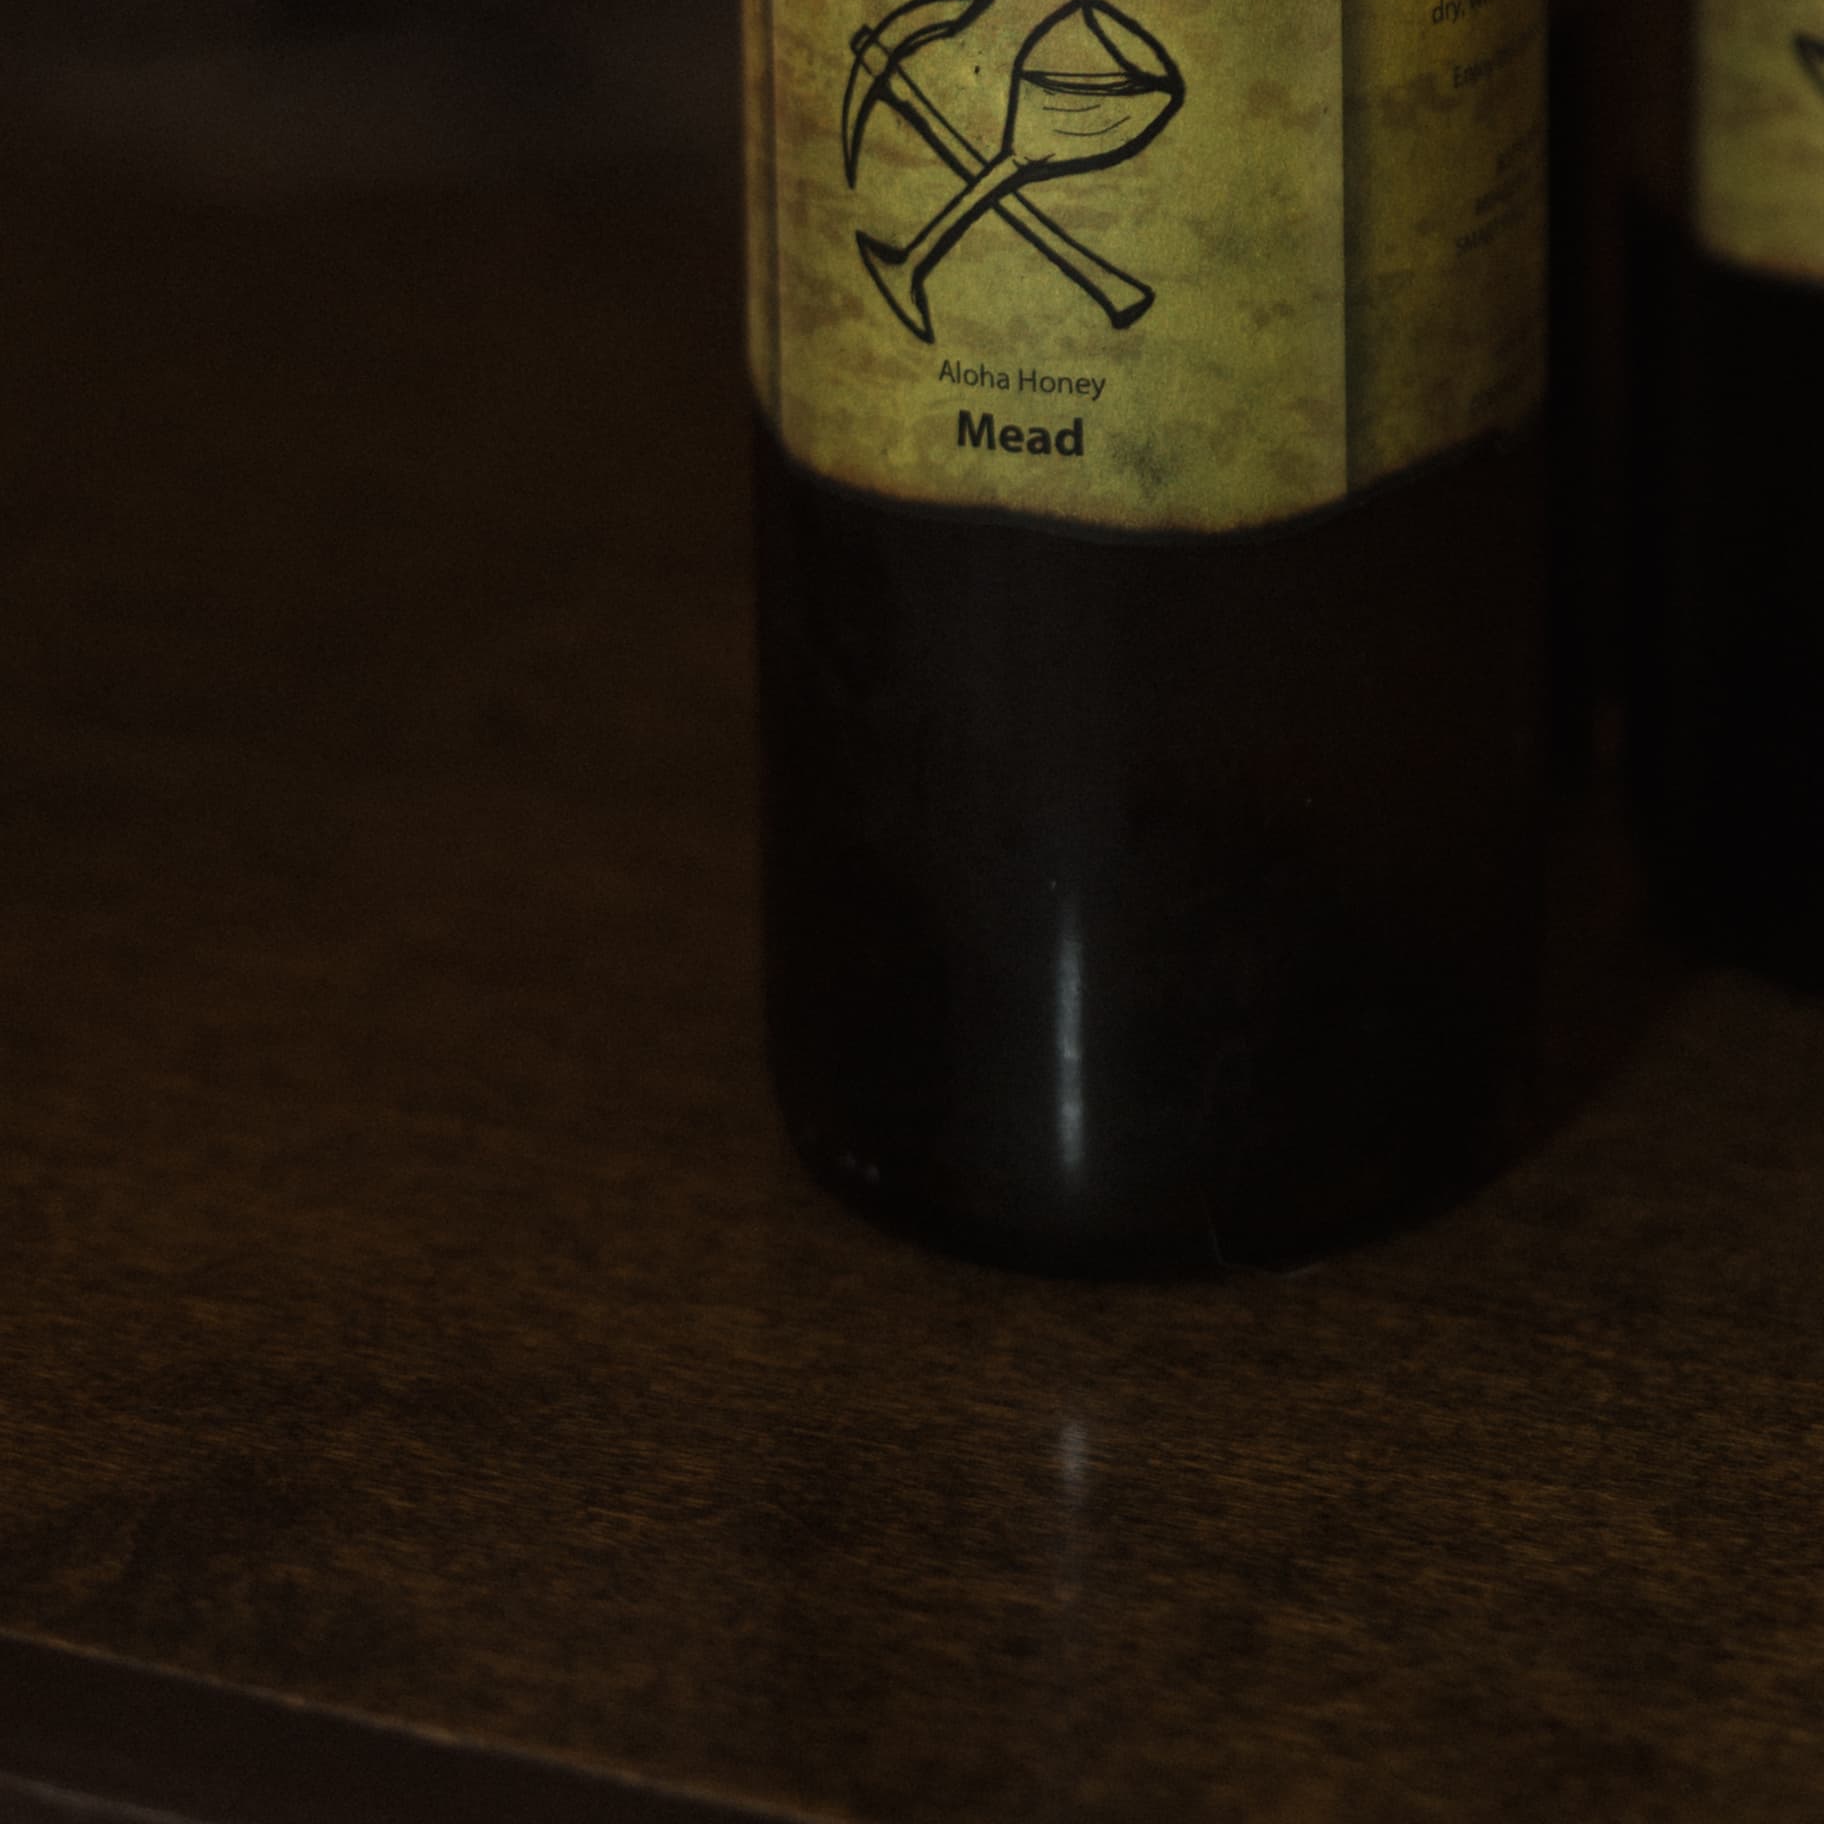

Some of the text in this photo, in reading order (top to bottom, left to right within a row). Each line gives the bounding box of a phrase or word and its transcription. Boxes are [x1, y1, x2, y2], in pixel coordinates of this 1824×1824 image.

[938, 359, 1107, 401] Aloha Honey
[956, 408, 1084, 457] Mead
